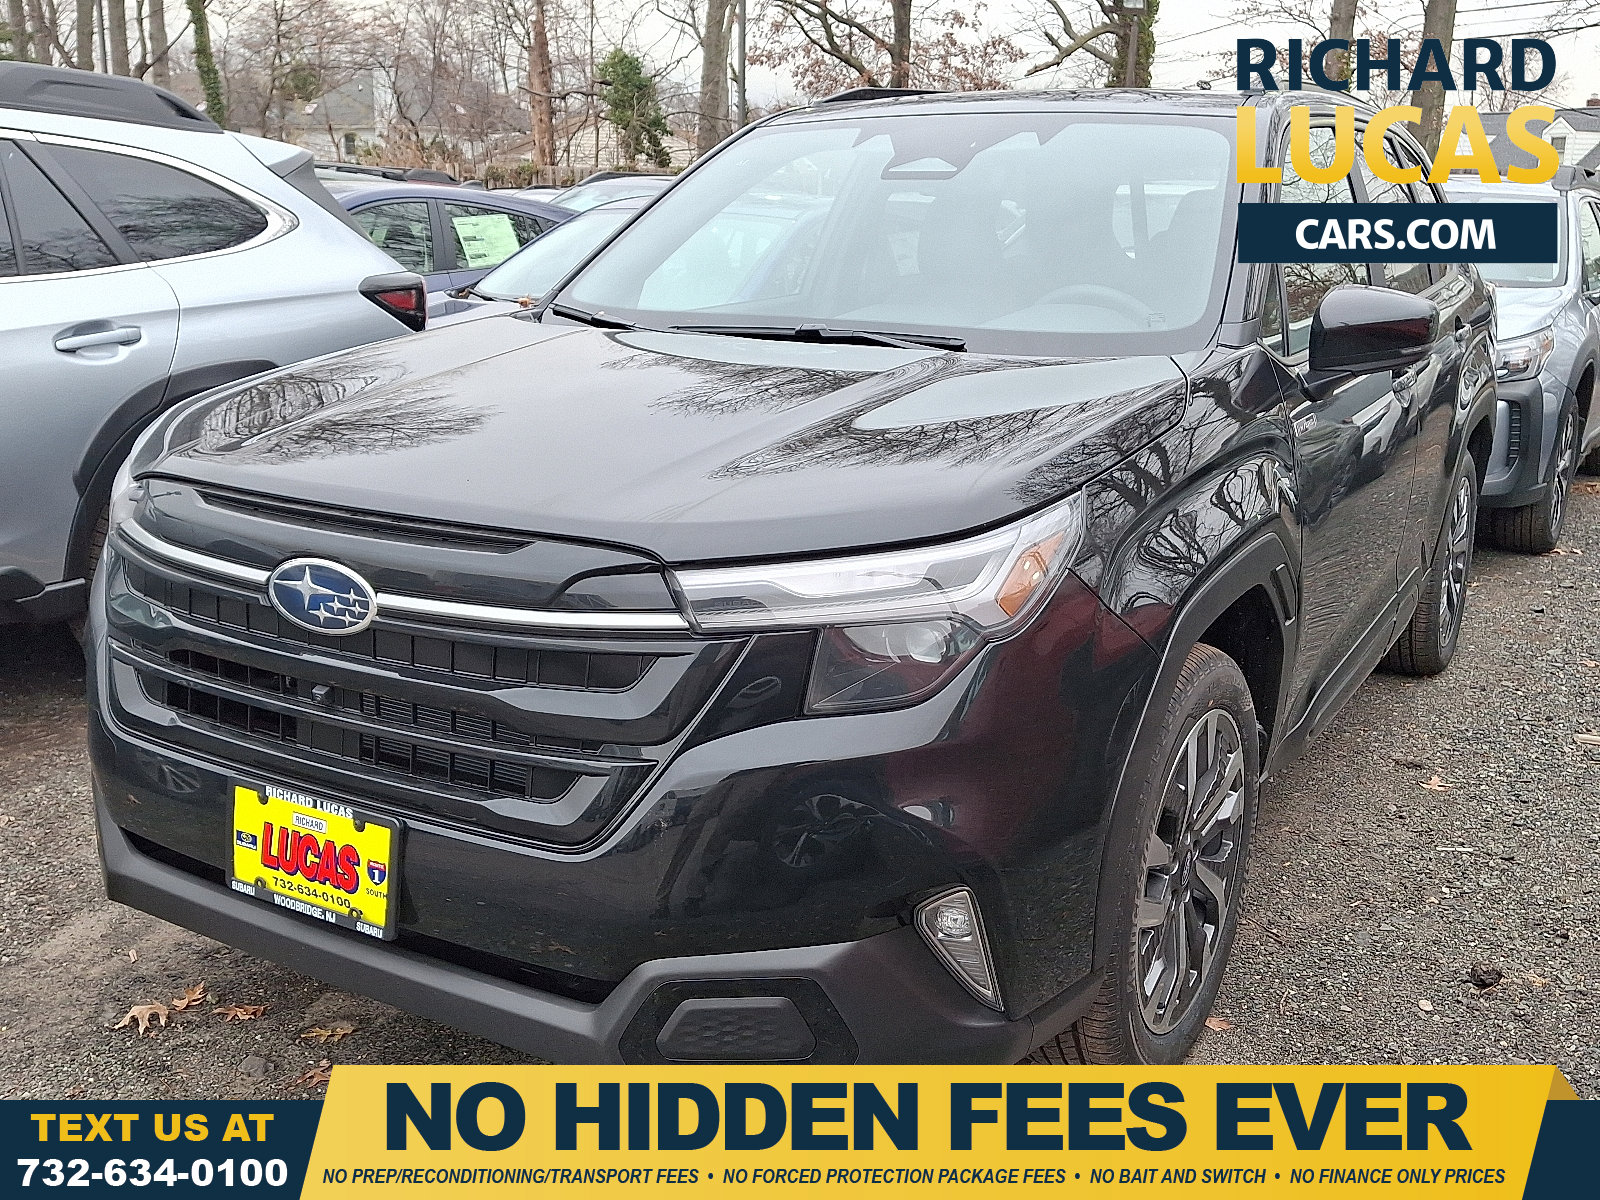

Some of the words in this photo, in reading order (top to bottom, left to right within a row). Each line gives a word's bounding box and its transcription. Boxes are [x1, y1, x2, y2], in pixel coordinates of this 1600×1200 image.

[265, 785, 313, 809] RICHARD
[316, 798, 353, 819] LUCAS
[295, 815, 324, 831] RICHARD
[261, 821, 360, 894] LUCAS
[372, 869, 381, 884] 1
[231, 880, 255, 896] SUBARU
[272, 876, 351, 909] 732-634-0100
[365, 887, 387, 899] SOUTH
[326, 911, 336, 923] NJ
[356, 921, 383, 938] SUBARU
